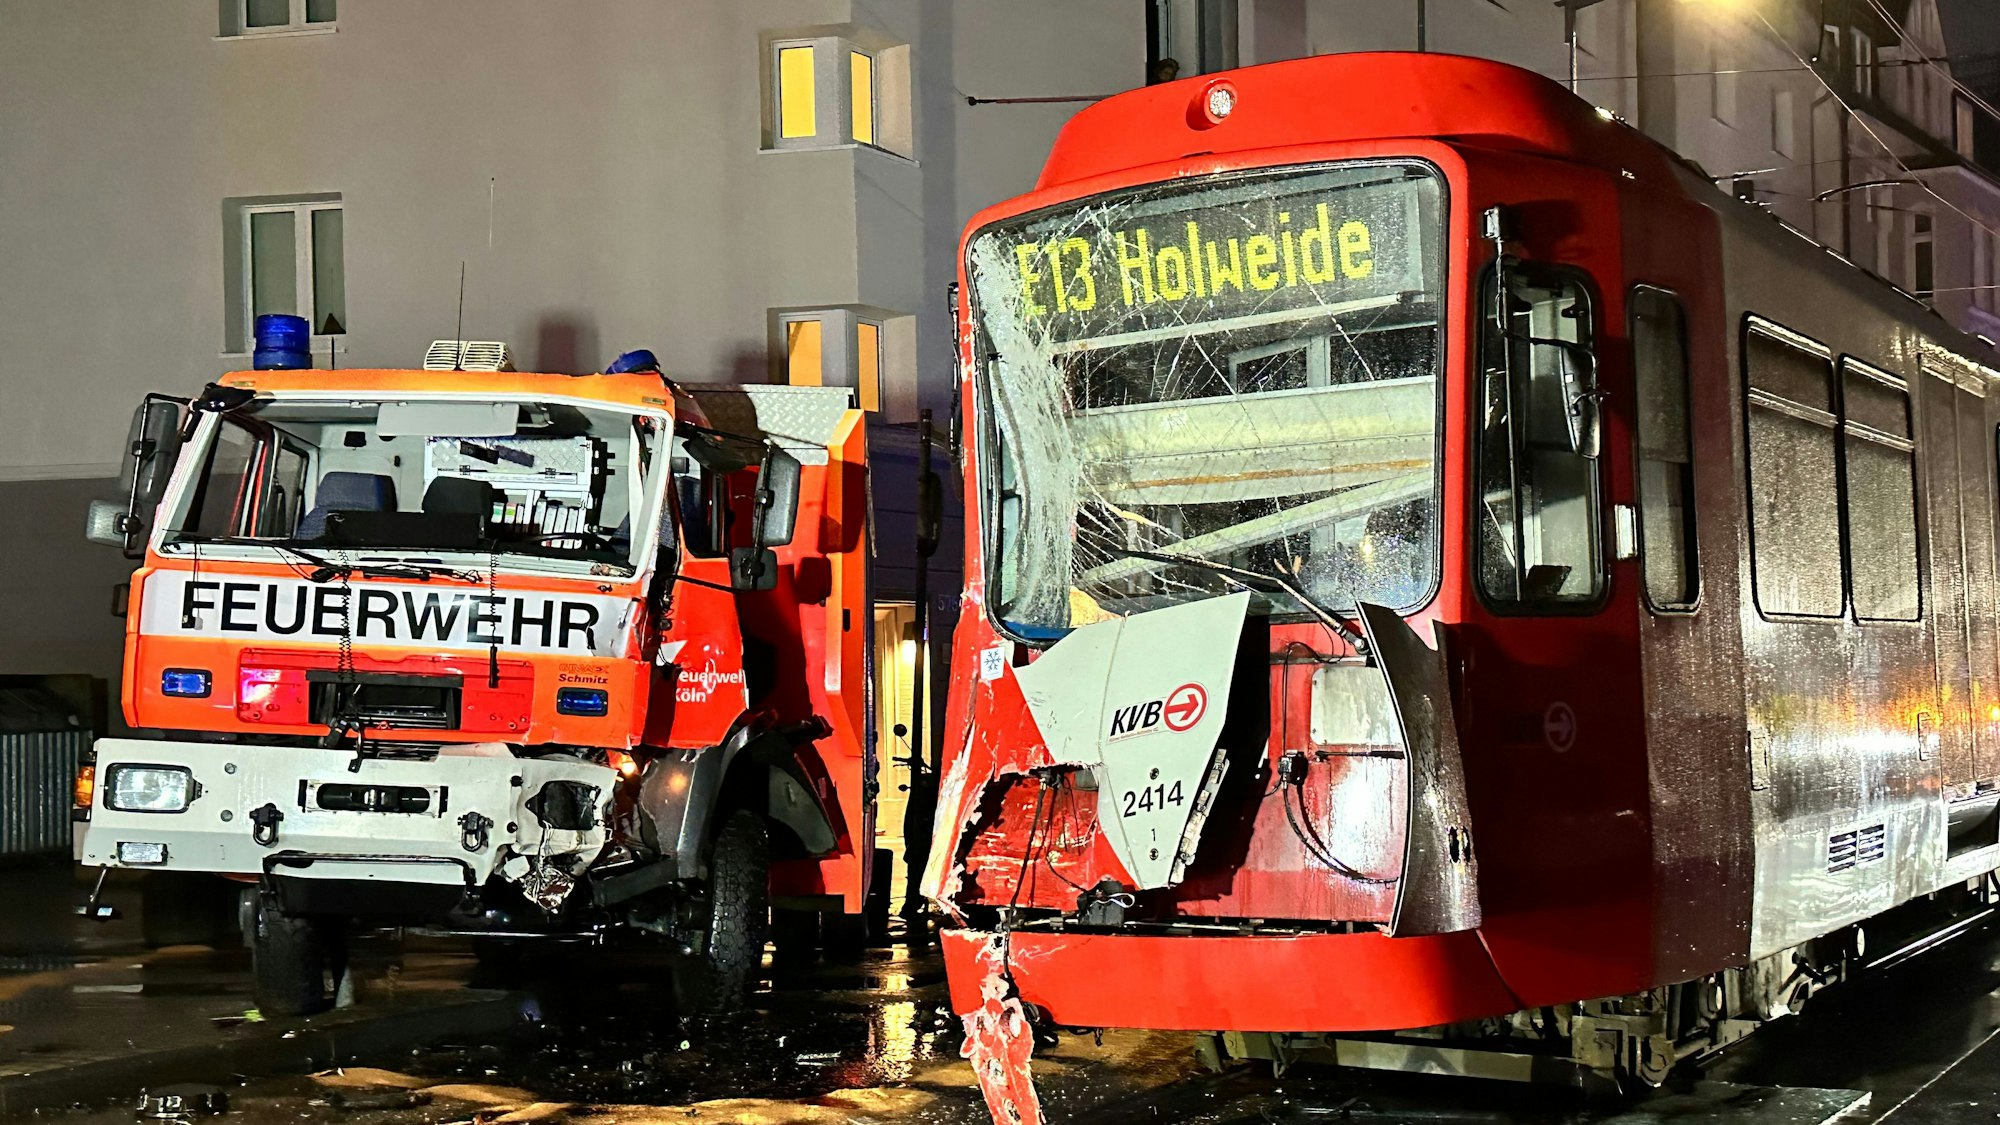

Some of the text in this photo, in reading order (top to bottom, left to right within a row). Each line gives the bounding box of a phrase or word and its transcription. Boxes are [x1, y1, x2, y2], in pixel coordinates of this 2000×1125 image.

[1016, 202, 1374, 315] E13 Holweide
[181, 580, 600, 650] FEUERWEHR
[558, 673, 609, 684] Schmitz
[1110, 700, 1163, 737] KVB
[1123, 780, 1184, 818] 2414
